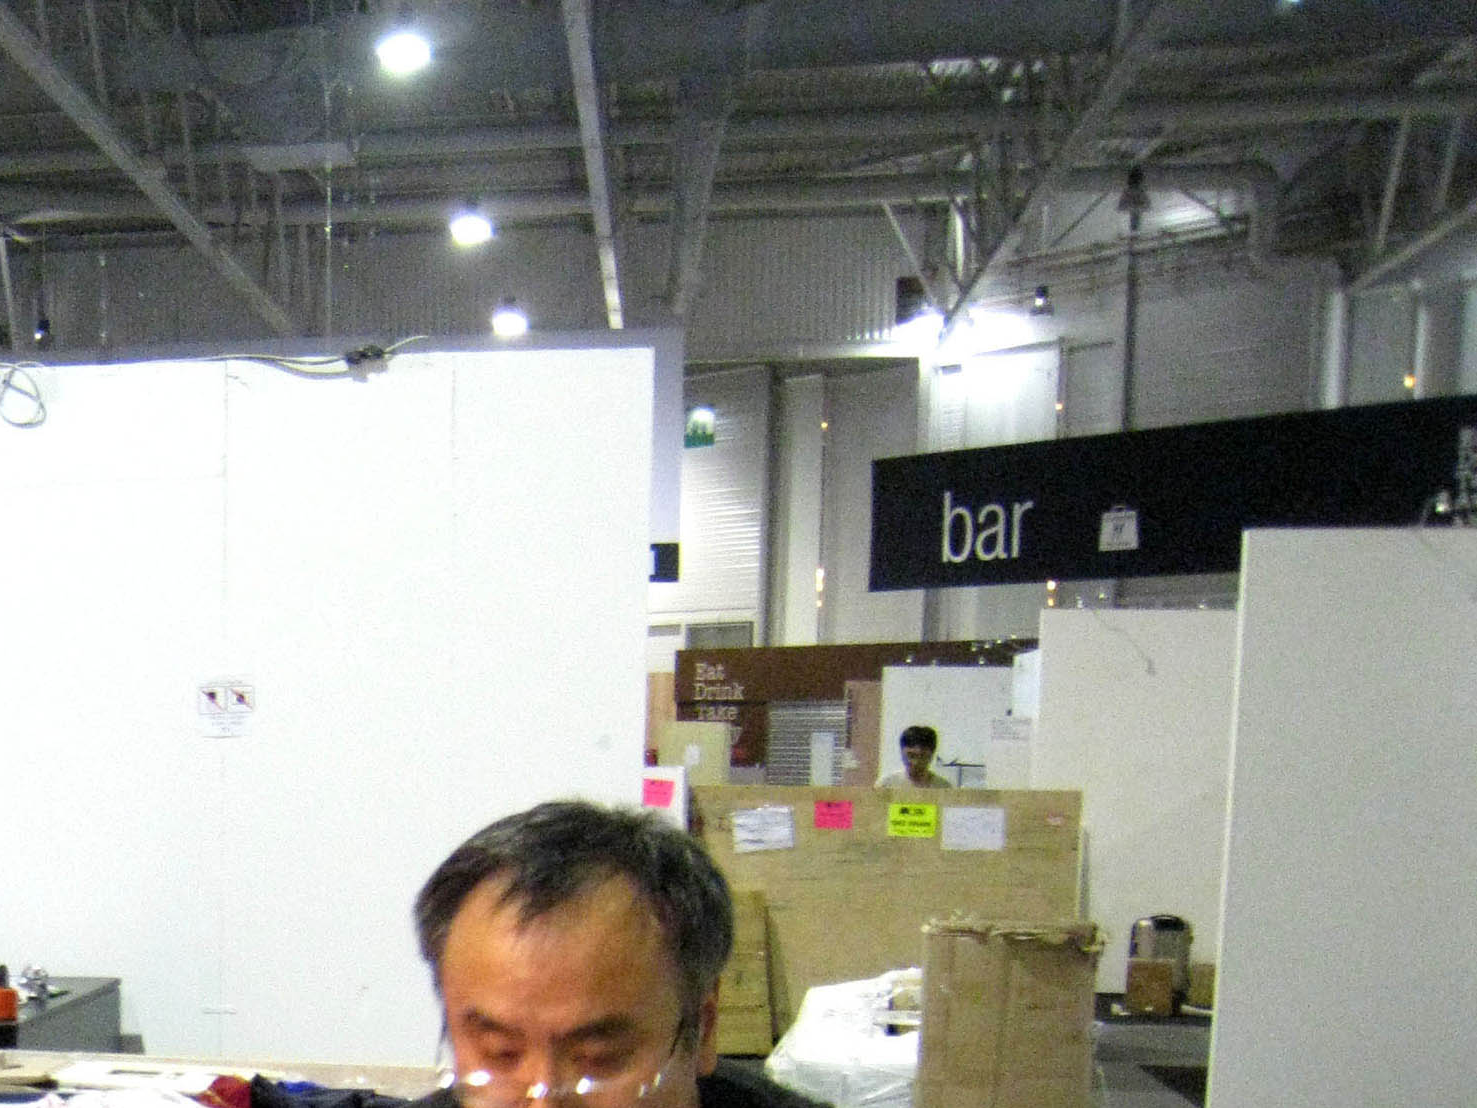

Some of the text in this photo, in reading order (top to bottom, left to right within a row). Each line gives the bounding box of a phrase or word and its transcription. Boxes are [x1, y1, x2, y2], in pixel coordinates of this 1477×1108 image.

[942, 490, 1034, 563] bar
[695, 662, 725, 681] Eat
[692, 682, 745, 700] Drink
